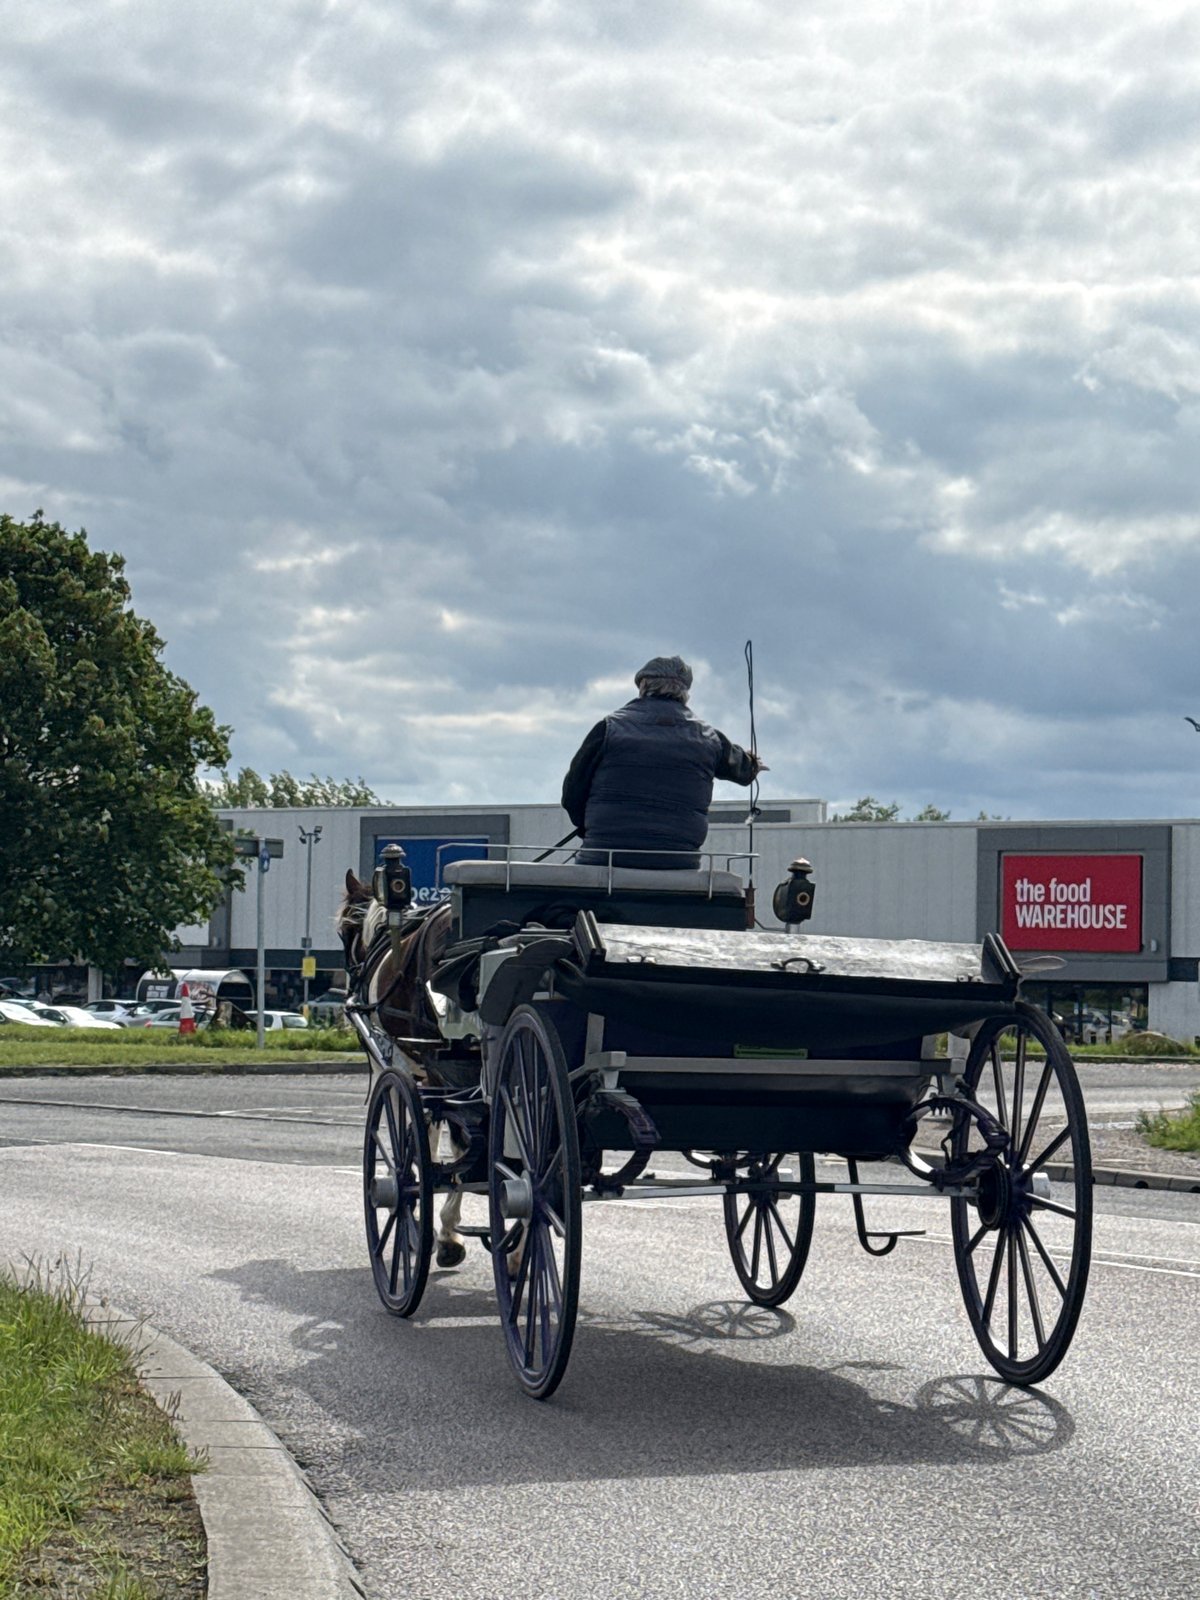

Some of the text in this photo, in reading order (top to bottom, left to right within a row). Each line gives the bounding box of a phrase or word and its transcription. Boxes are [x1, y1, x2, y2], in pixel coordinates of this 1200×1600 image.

[1015, 878, 1090, 902] the food
[1015, 904, 1127, 928] WAREHOUSE
